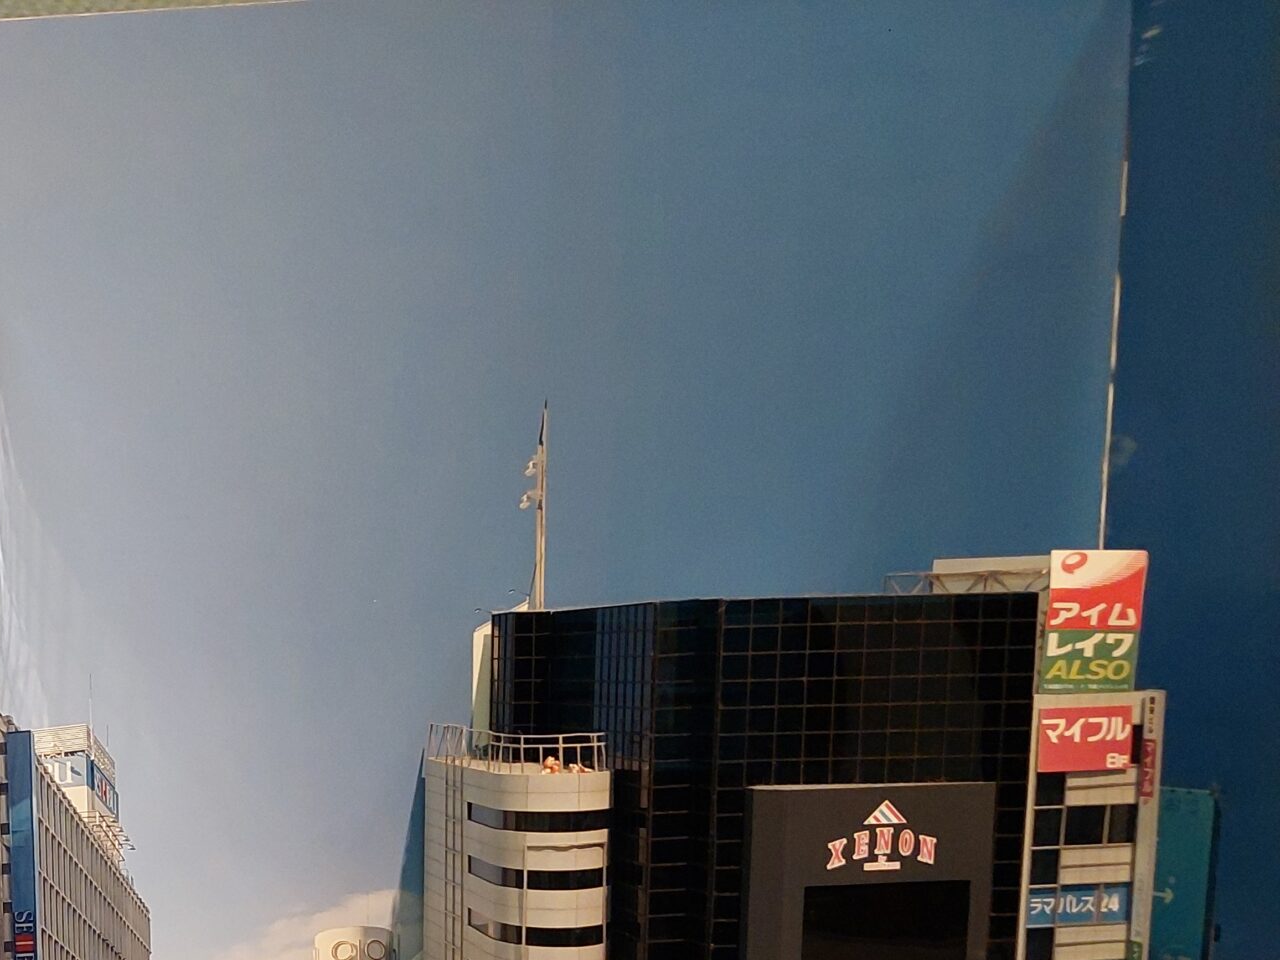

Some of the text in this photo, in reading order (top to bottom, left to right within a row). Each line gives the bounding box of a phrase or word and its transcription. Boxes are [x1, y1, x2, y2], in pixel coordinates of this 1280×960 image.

[1050, 602, 1137, 626] アイム
[1046, 632, 1134, 657] レイワ
[1045, 659, 1131, 680] ALSO
[1041, 717, 1133, 743] マイフル
[826, 827, 937, 870] XENON
